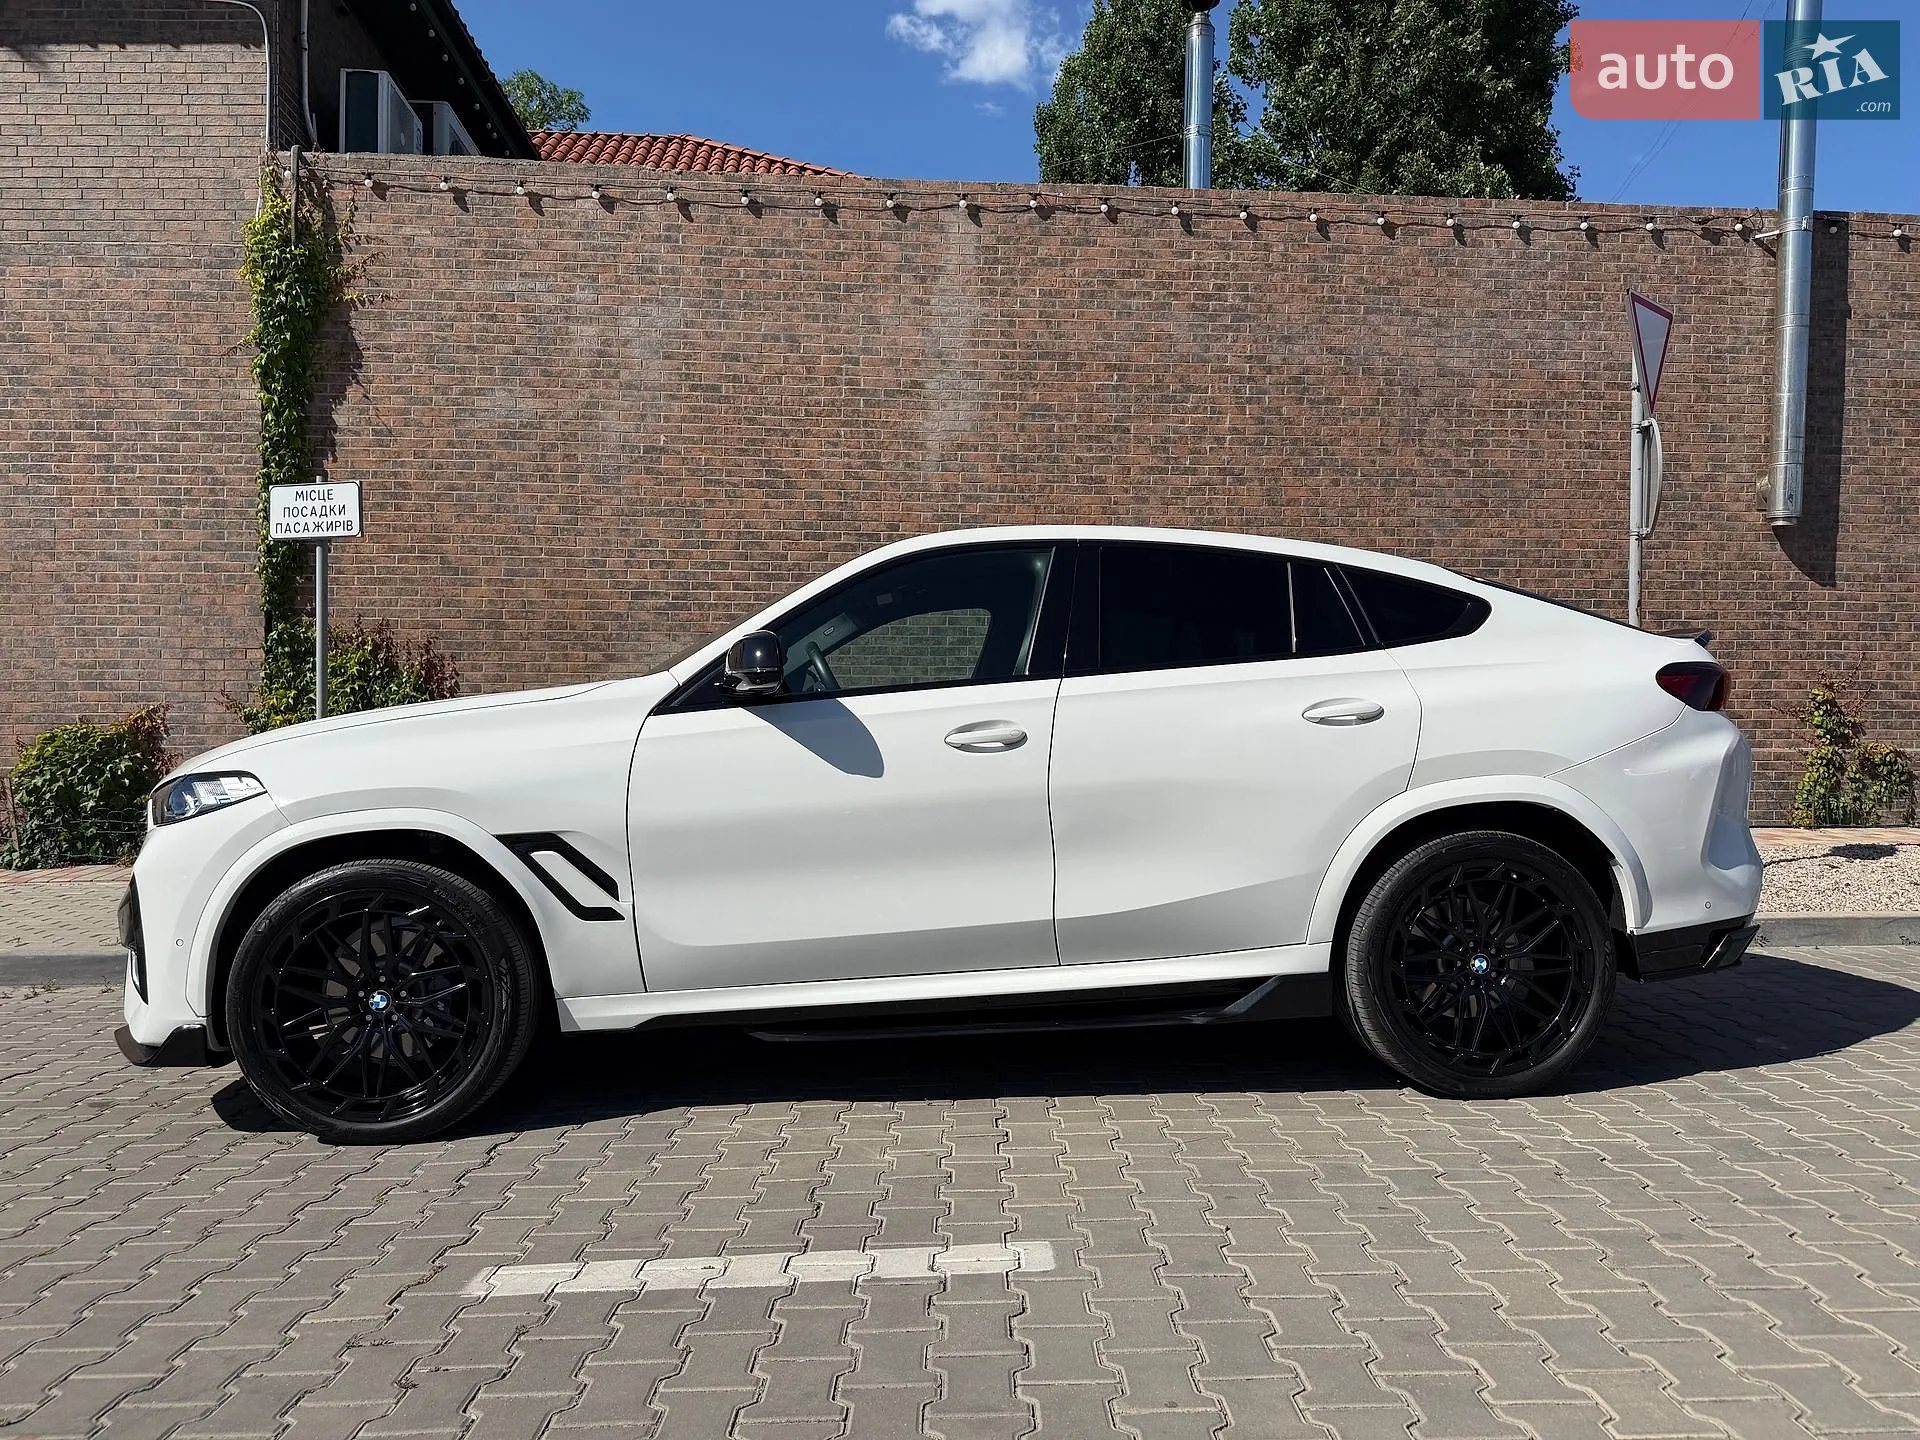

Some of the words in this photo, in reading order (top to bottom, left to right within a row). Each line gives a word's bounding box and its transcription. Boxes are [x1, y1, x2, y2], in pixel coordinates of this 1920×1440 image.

[295, 489, 334, 502] МІСЦЕ
[283, 504, 346, 518] ПОСАДКИ
[275, 520, 354, 534] ПАСАЖИРІВ
